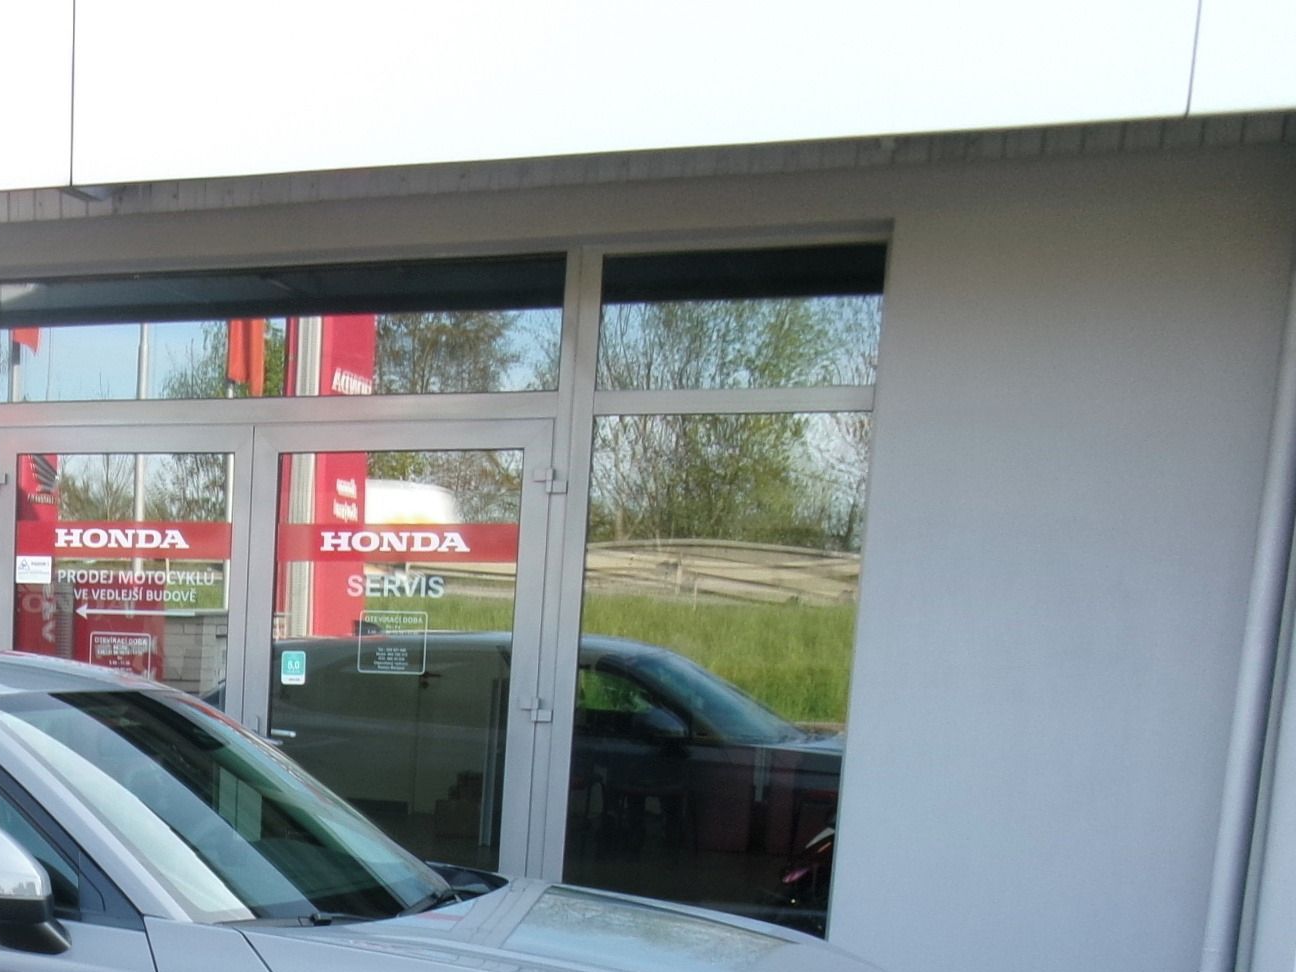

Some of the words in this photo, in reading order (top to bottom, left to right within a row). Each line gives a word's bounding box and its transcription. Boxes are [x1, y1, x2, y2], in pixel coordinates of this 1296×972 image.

[54, 528, 190, 549] HONDA
[320, 531, 471, 552] HONDA
[57, 569, 114, 585] PRODEJ
[118, 567, 215, 586] MOTOCYKLŮ
[347, 574, 445, 599] SERVIS
[73, 588, 89, 601] VE
[91, 587, 144, 602] VEDLEJŠÍ
[146, 588, 197, 603] BUDOVĚ
